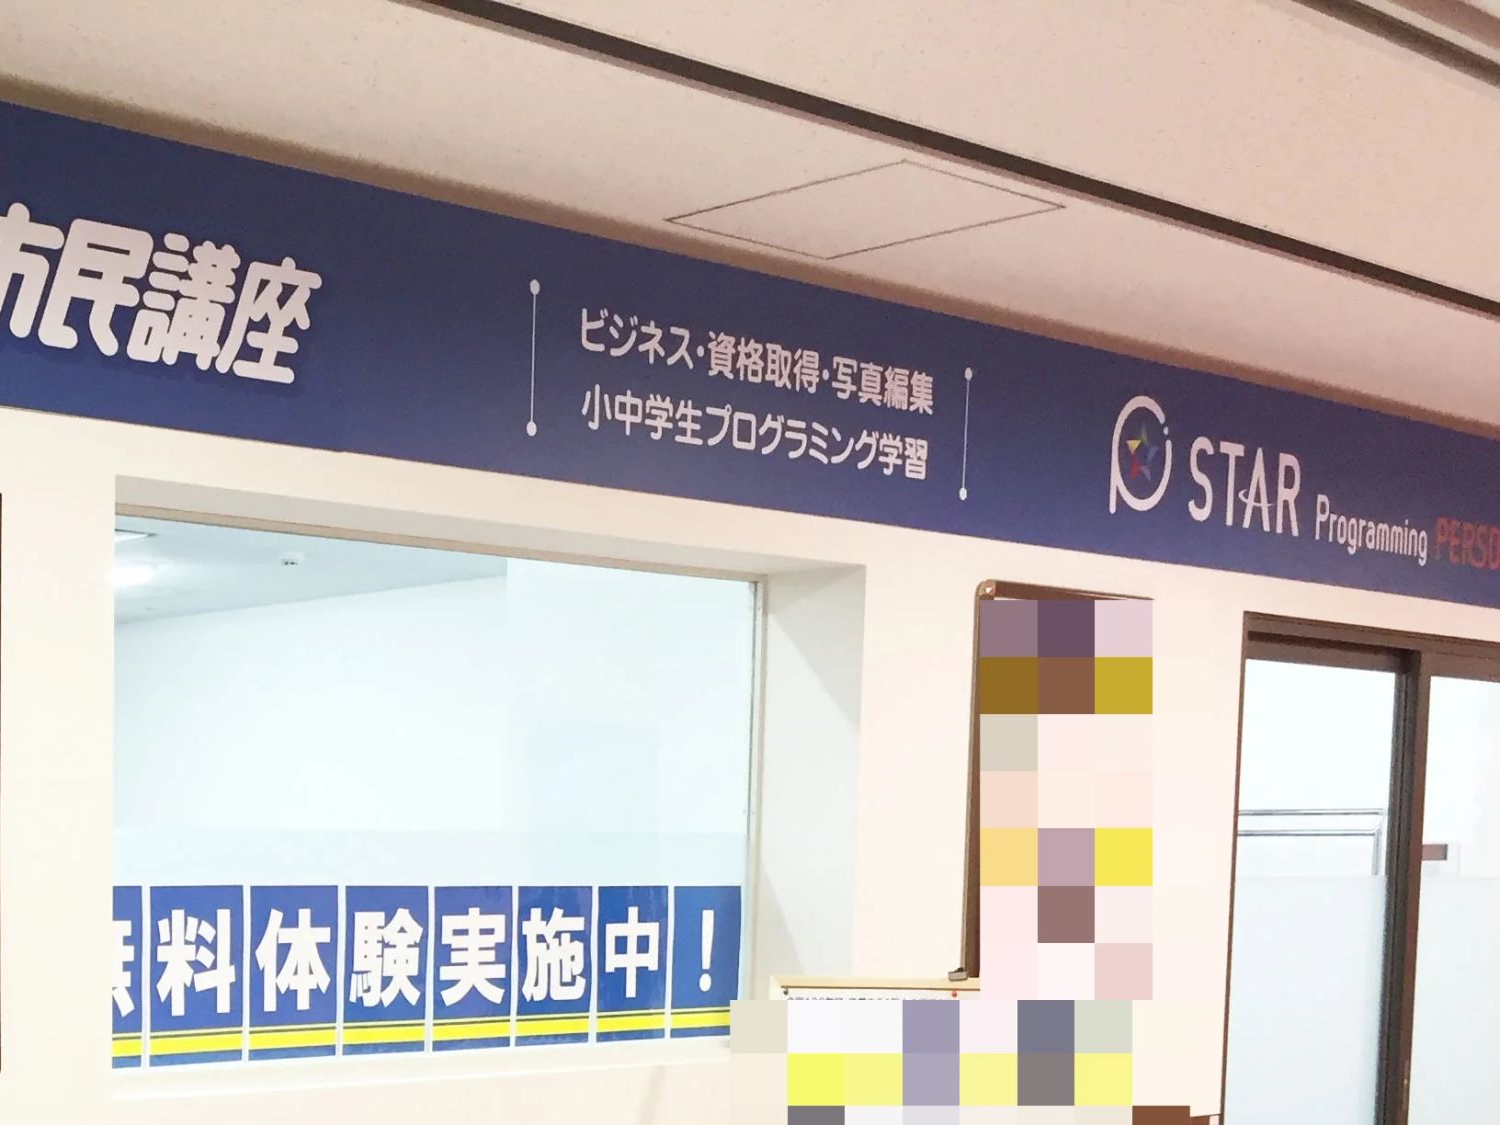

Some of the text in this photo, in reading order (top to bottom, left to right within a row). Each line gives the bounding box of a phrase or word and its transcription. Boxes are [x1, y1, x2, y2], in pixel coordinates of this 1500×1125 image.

[581, 308, 934, 415] ビジネス・資格取得・写真編集
[581, 384, 929, 480] 小中学生プログラミング学習
[1187, 436, 1299, 537] STAR
[1315, 494, 1428, 567] Programming
